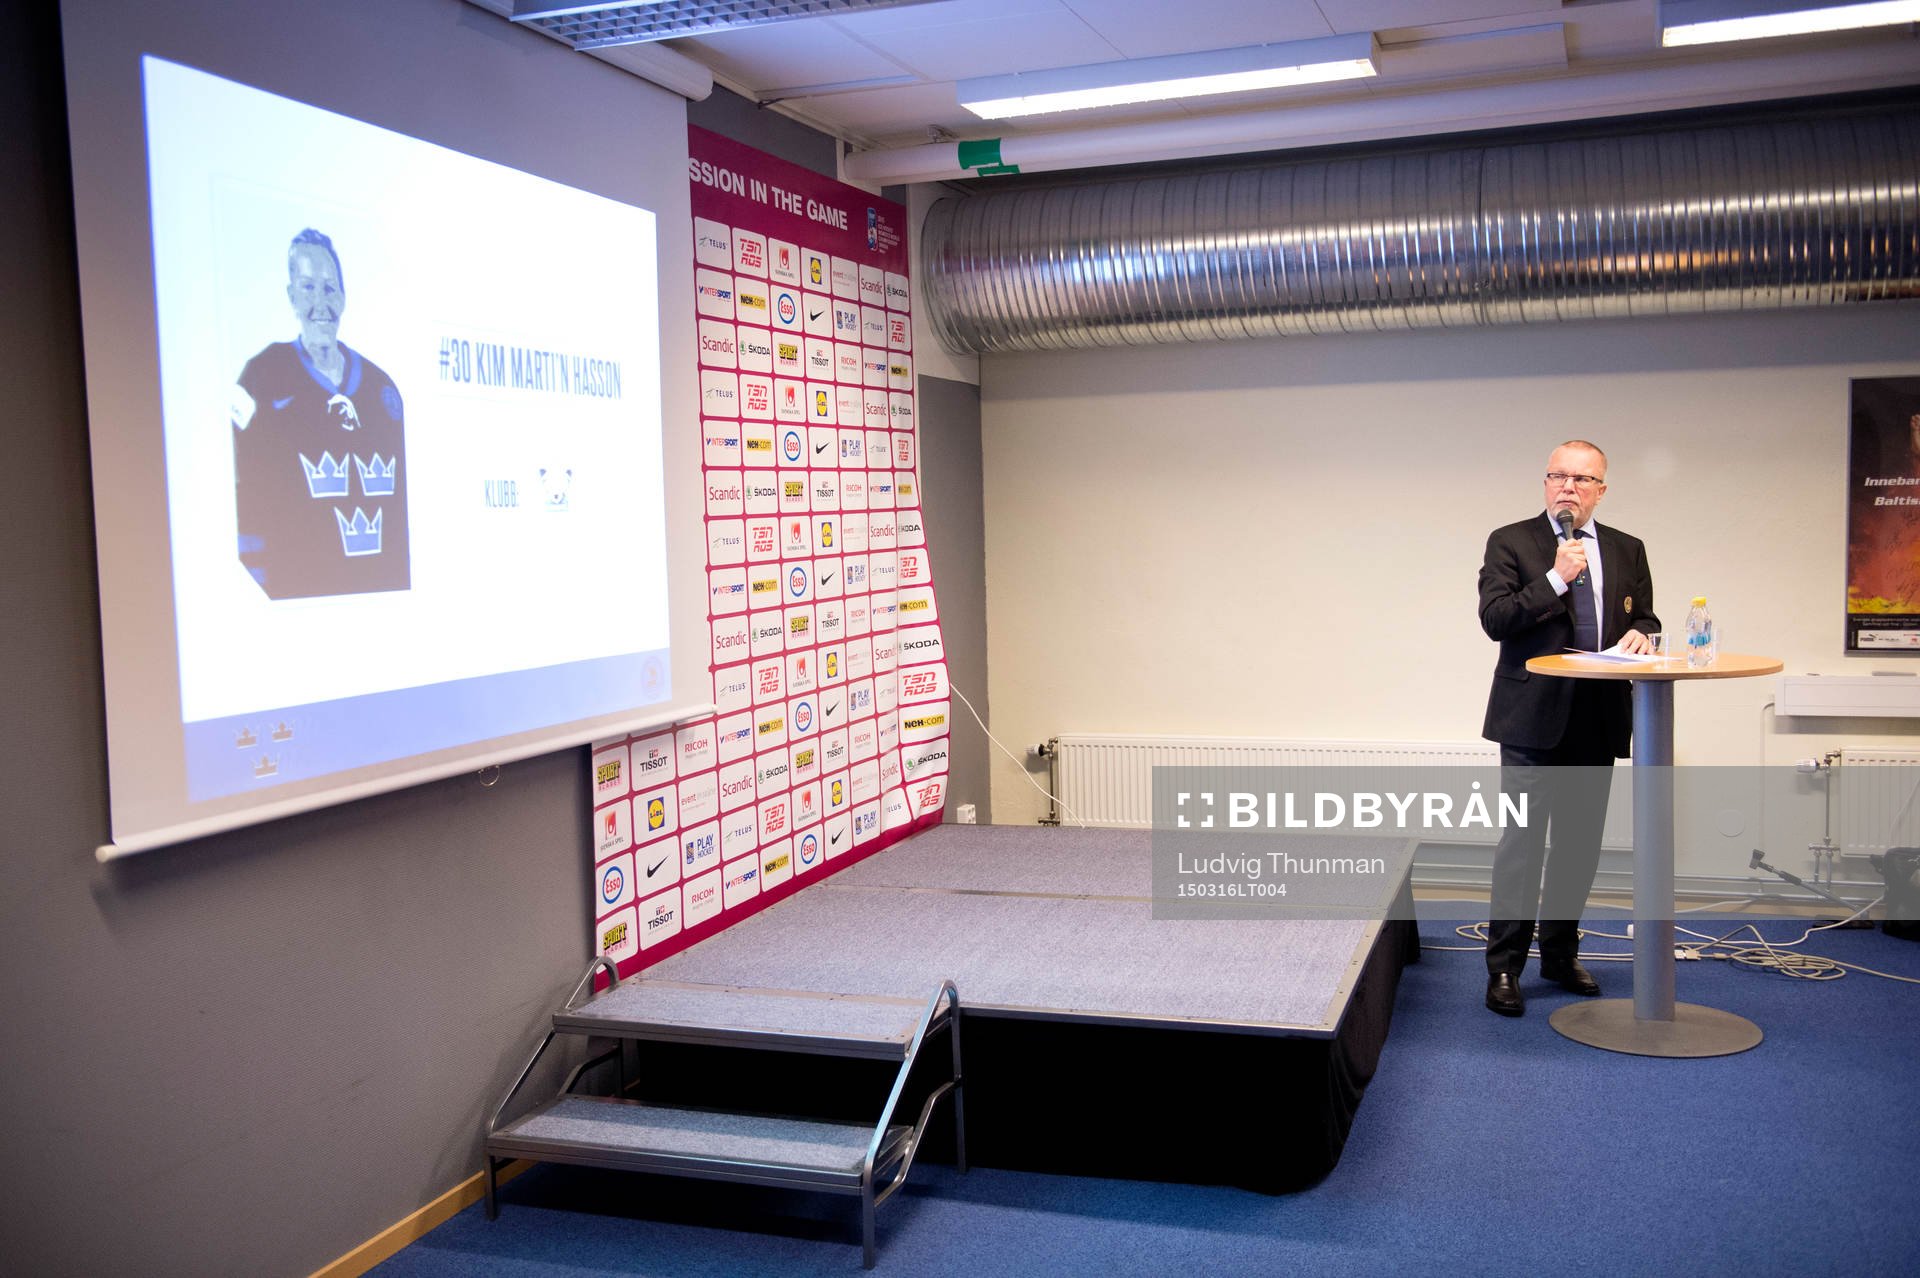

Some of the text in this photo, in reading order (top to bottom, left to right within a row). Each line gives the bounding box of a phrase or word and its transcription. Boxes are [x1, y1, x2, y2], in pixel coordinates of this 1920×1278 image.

[750, 178, 768, 204] IN
[771, 186, 803, 216] THE
[807, 198, 848, 231] GAME
[709, 238, 726, 250] TELUS
[702, 335, 734, 354] Scandic
[440, 336, 621, 400] #30 KIM MARTI'N HASSON
[811, 356, 829, 367] TISSOT
[715, 389, 734, 399] TELUS
[747, 383, 768, 397] TSN
[786, 440, 799, 452] Esso
[709, 485, 740, 501] Scandic
[816, 489, 834, 498] TISSOT
[752, 526, 773, 539] TSN
[870, 524, 895, 538] Scandic
[722, 537, 740, 545] TELUS
[792, 575, 804, 588] Esso
[822, 618, 840, 629] TISSOT
[716, 631, 747, 649] Scandic
[904, 639, 940, 650] ŠKODA
[758, 666, 779, 681] TSN
[902, 671, 936, 686] TSN
[729, 682, 746, 693] TELUS
[904, 682, 938, 697] RDS
[797, 711, 810, 723] Esso
[684, 739, 708, 753] RICOH
[826, 746, 844, 759] TISSOT
[640, 756, 668, 772] TISSOT
[597, 761, 621, 784] SPORT
[722, 775, 753, 798] Scandic
[764, 803, 785, 821] TSN
[735, 825, 752, 837] TELUS
[765, 816, 785, 835] RDS
[697, 834, 713, 850] PLAY
[605, 877, 620, 895] Esso
[691, 887, 714, 904] RICOH
[648, 910, 674, 930] TISSOT
[603, 922, 627, 950] SPORT
